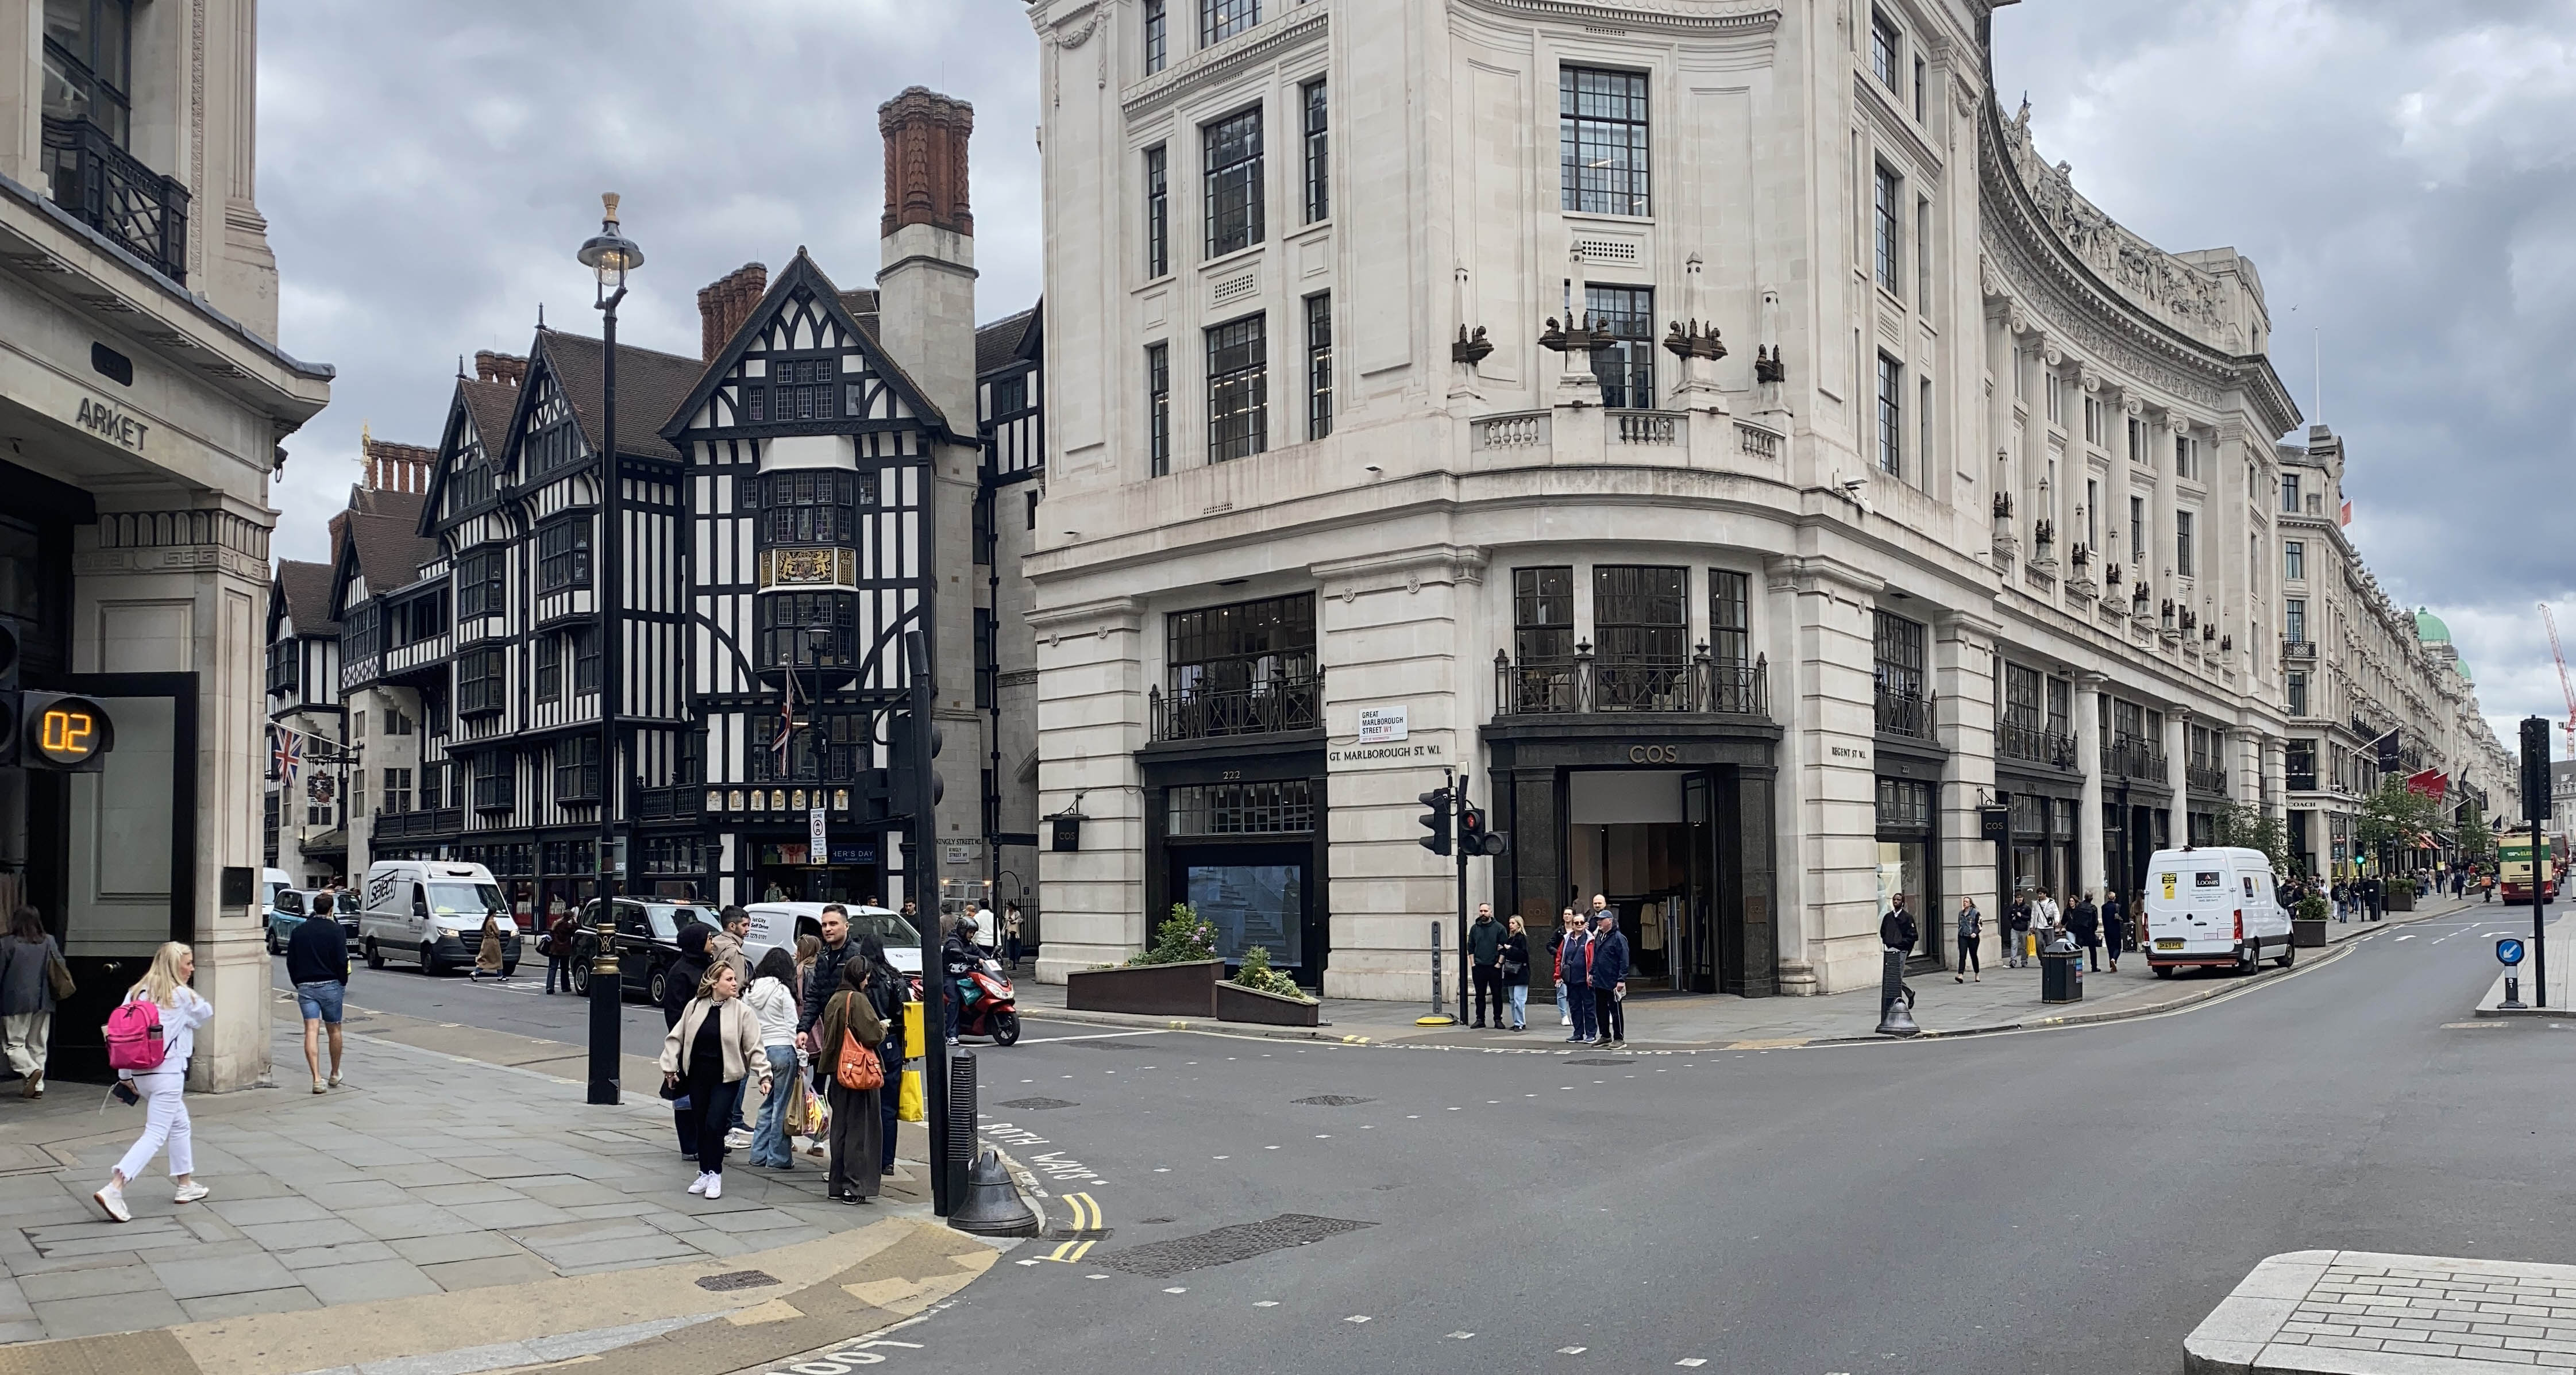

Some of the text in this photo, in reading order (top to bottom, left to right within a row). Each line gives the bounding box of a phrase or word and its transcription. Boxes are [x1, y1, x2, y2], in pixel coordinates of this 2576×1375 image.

[76, 397, 149, 450] ARKET
[1362, 717, 1403, 726] MARLBOROUGH
[1362, 726, 1382, 734] STREET
[43, 711, 92, 753] 02
[1329, 752, 1341, 761] GT.
[1344, 748, 1410, 760] MARLBOROUGH
[1629, 745, 1677, 764] COS
[1832, 746, 1850, 757] REGENT
[1223, 770, 1240, 780] 222
[1059, 831, 1075, 840] COS
[371, 874, 396, 903] select
[977, 1123, 1050, 1145] BOTH
[1029, 1151, 1098, 1180] WAYS
[765, 1340, 925, 1375] LOO
